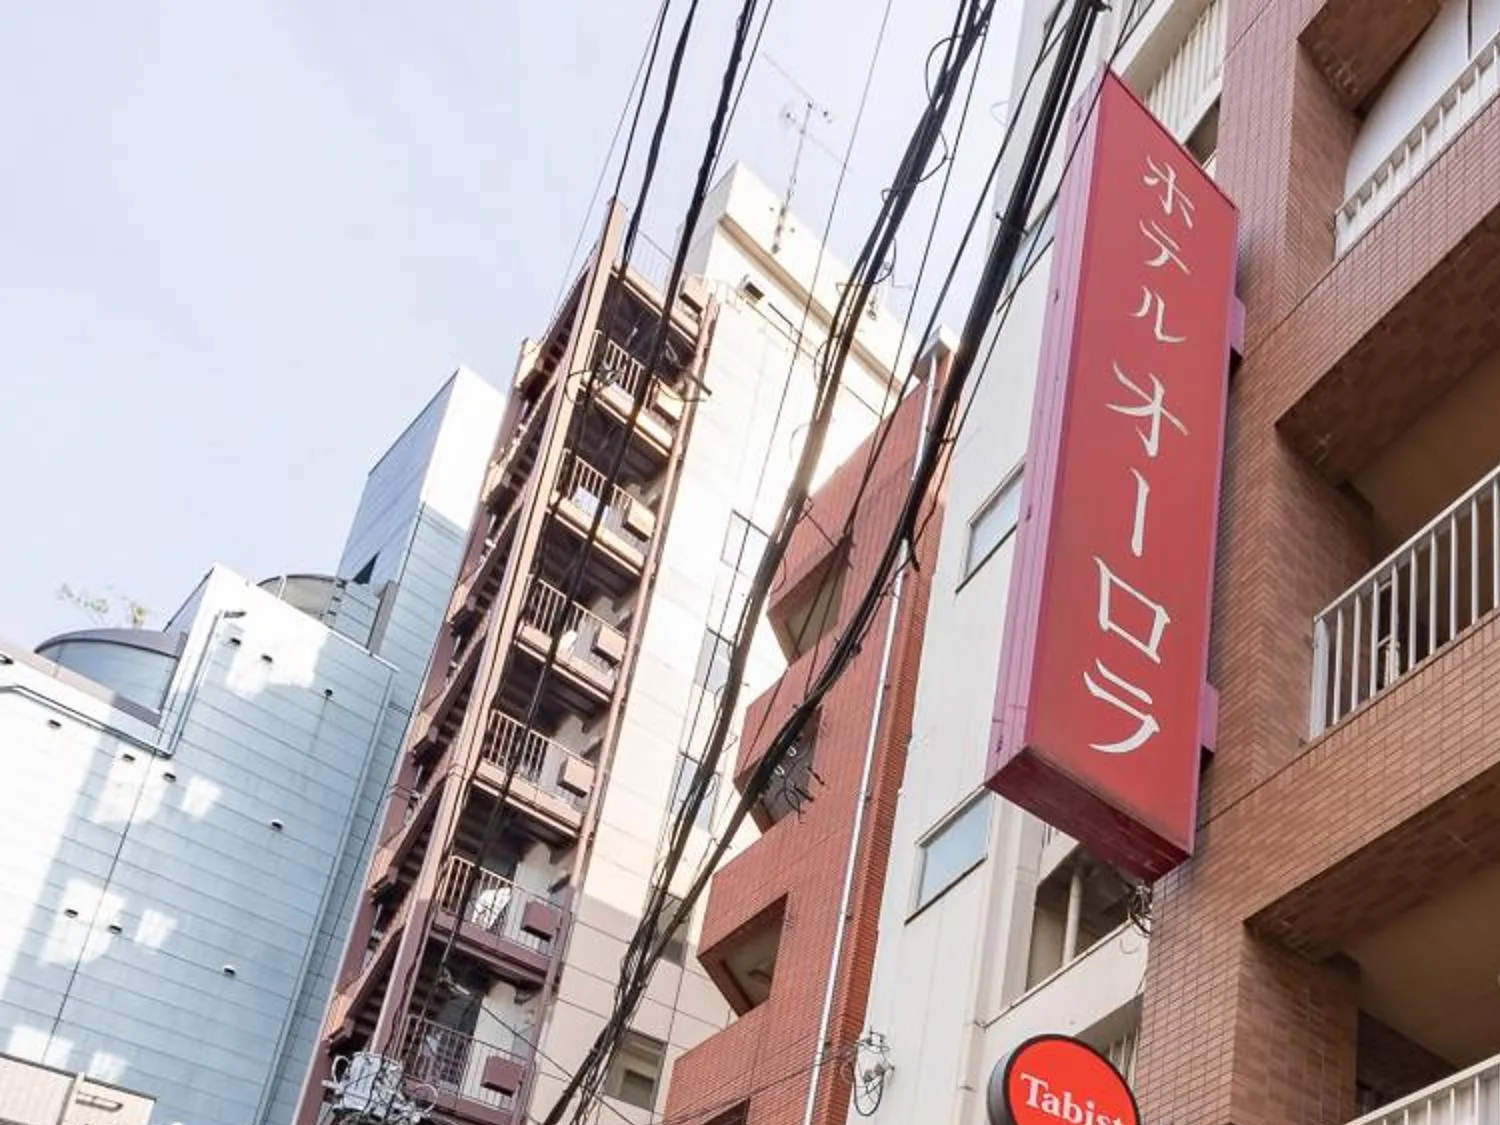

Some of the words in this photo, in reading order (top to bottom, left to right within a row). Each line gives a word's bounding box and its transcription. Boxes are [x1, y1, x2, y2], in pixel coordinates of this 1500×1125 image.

[1083, 154, 1193, 755] ホテルオーロラ
